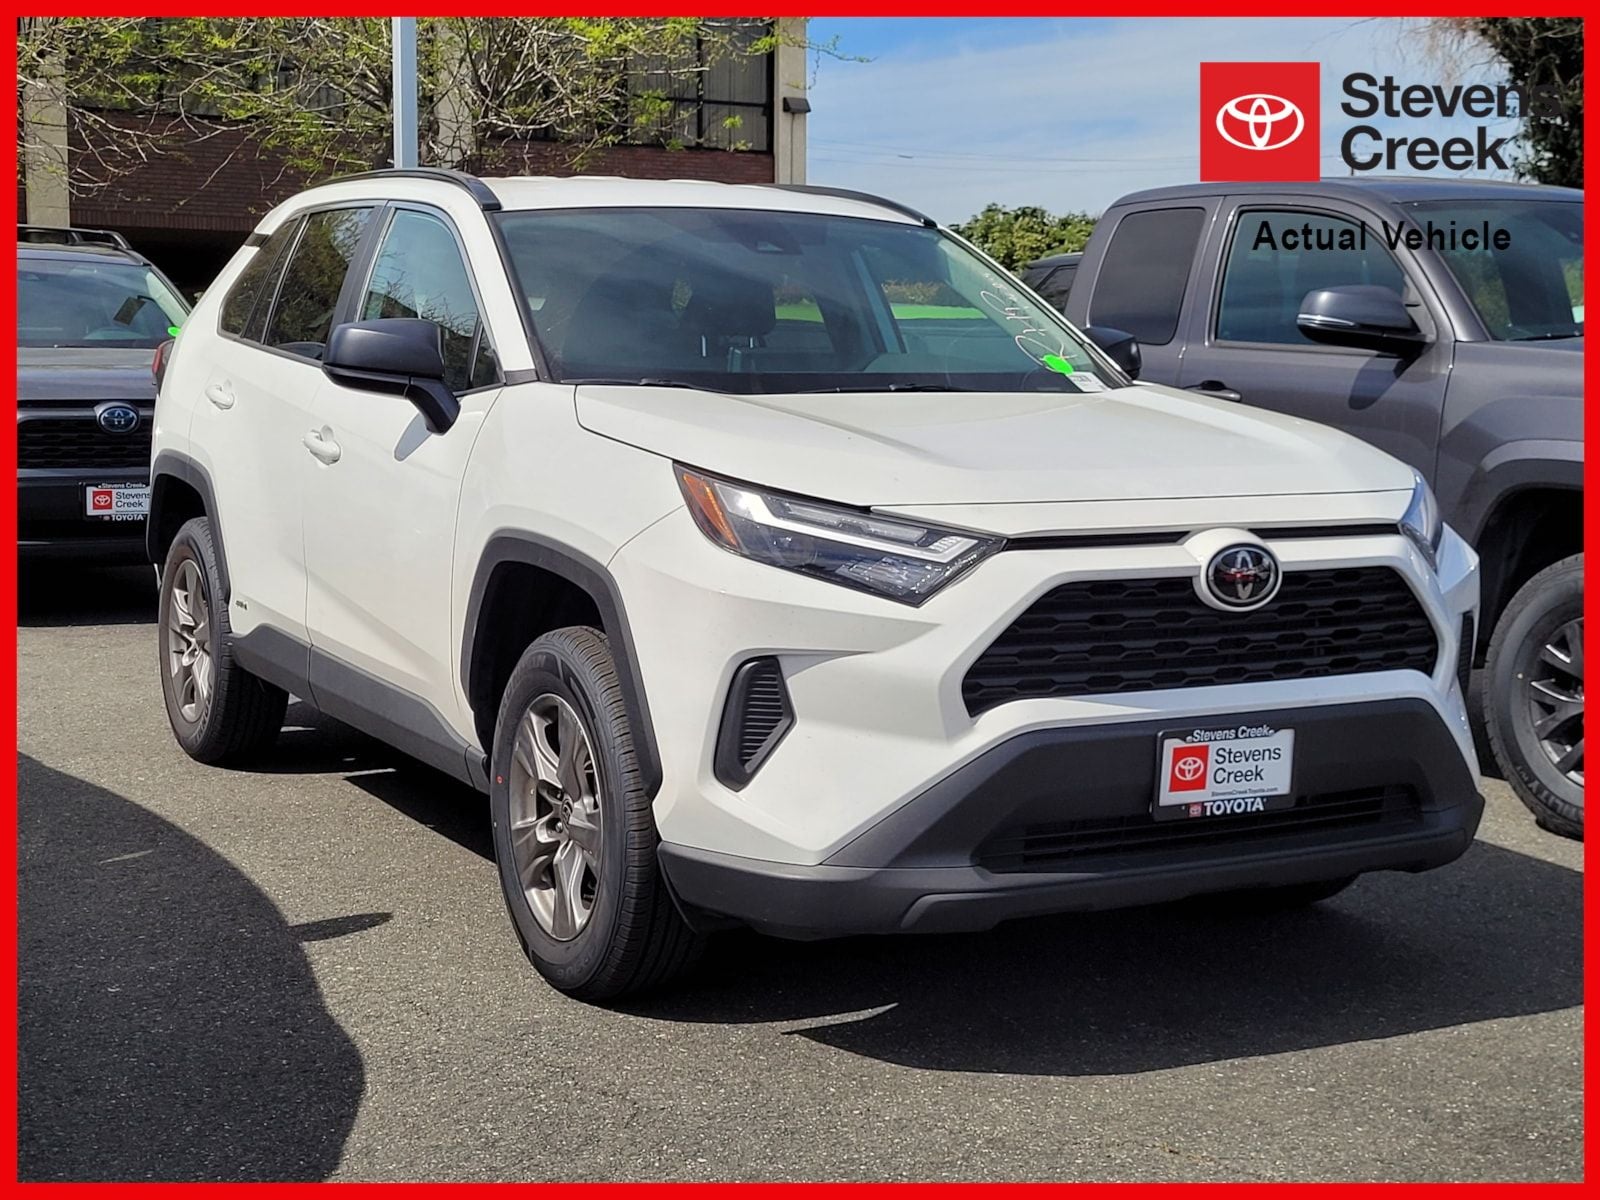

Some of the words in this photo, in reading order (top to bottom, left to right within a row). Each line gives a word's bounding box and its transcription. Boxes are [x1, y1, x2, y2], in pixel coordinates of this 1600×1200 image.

[115, 500, 144, 508] Creek
[1192, 728, 1236, 742] Stevens
[1238, 724, 1271, 739] Creek
[1214, 746, 1282, 765] Stevens
[1213, 764, 1264, 785] Creek
[1203, 797, 1265, 817] TOYOTA
